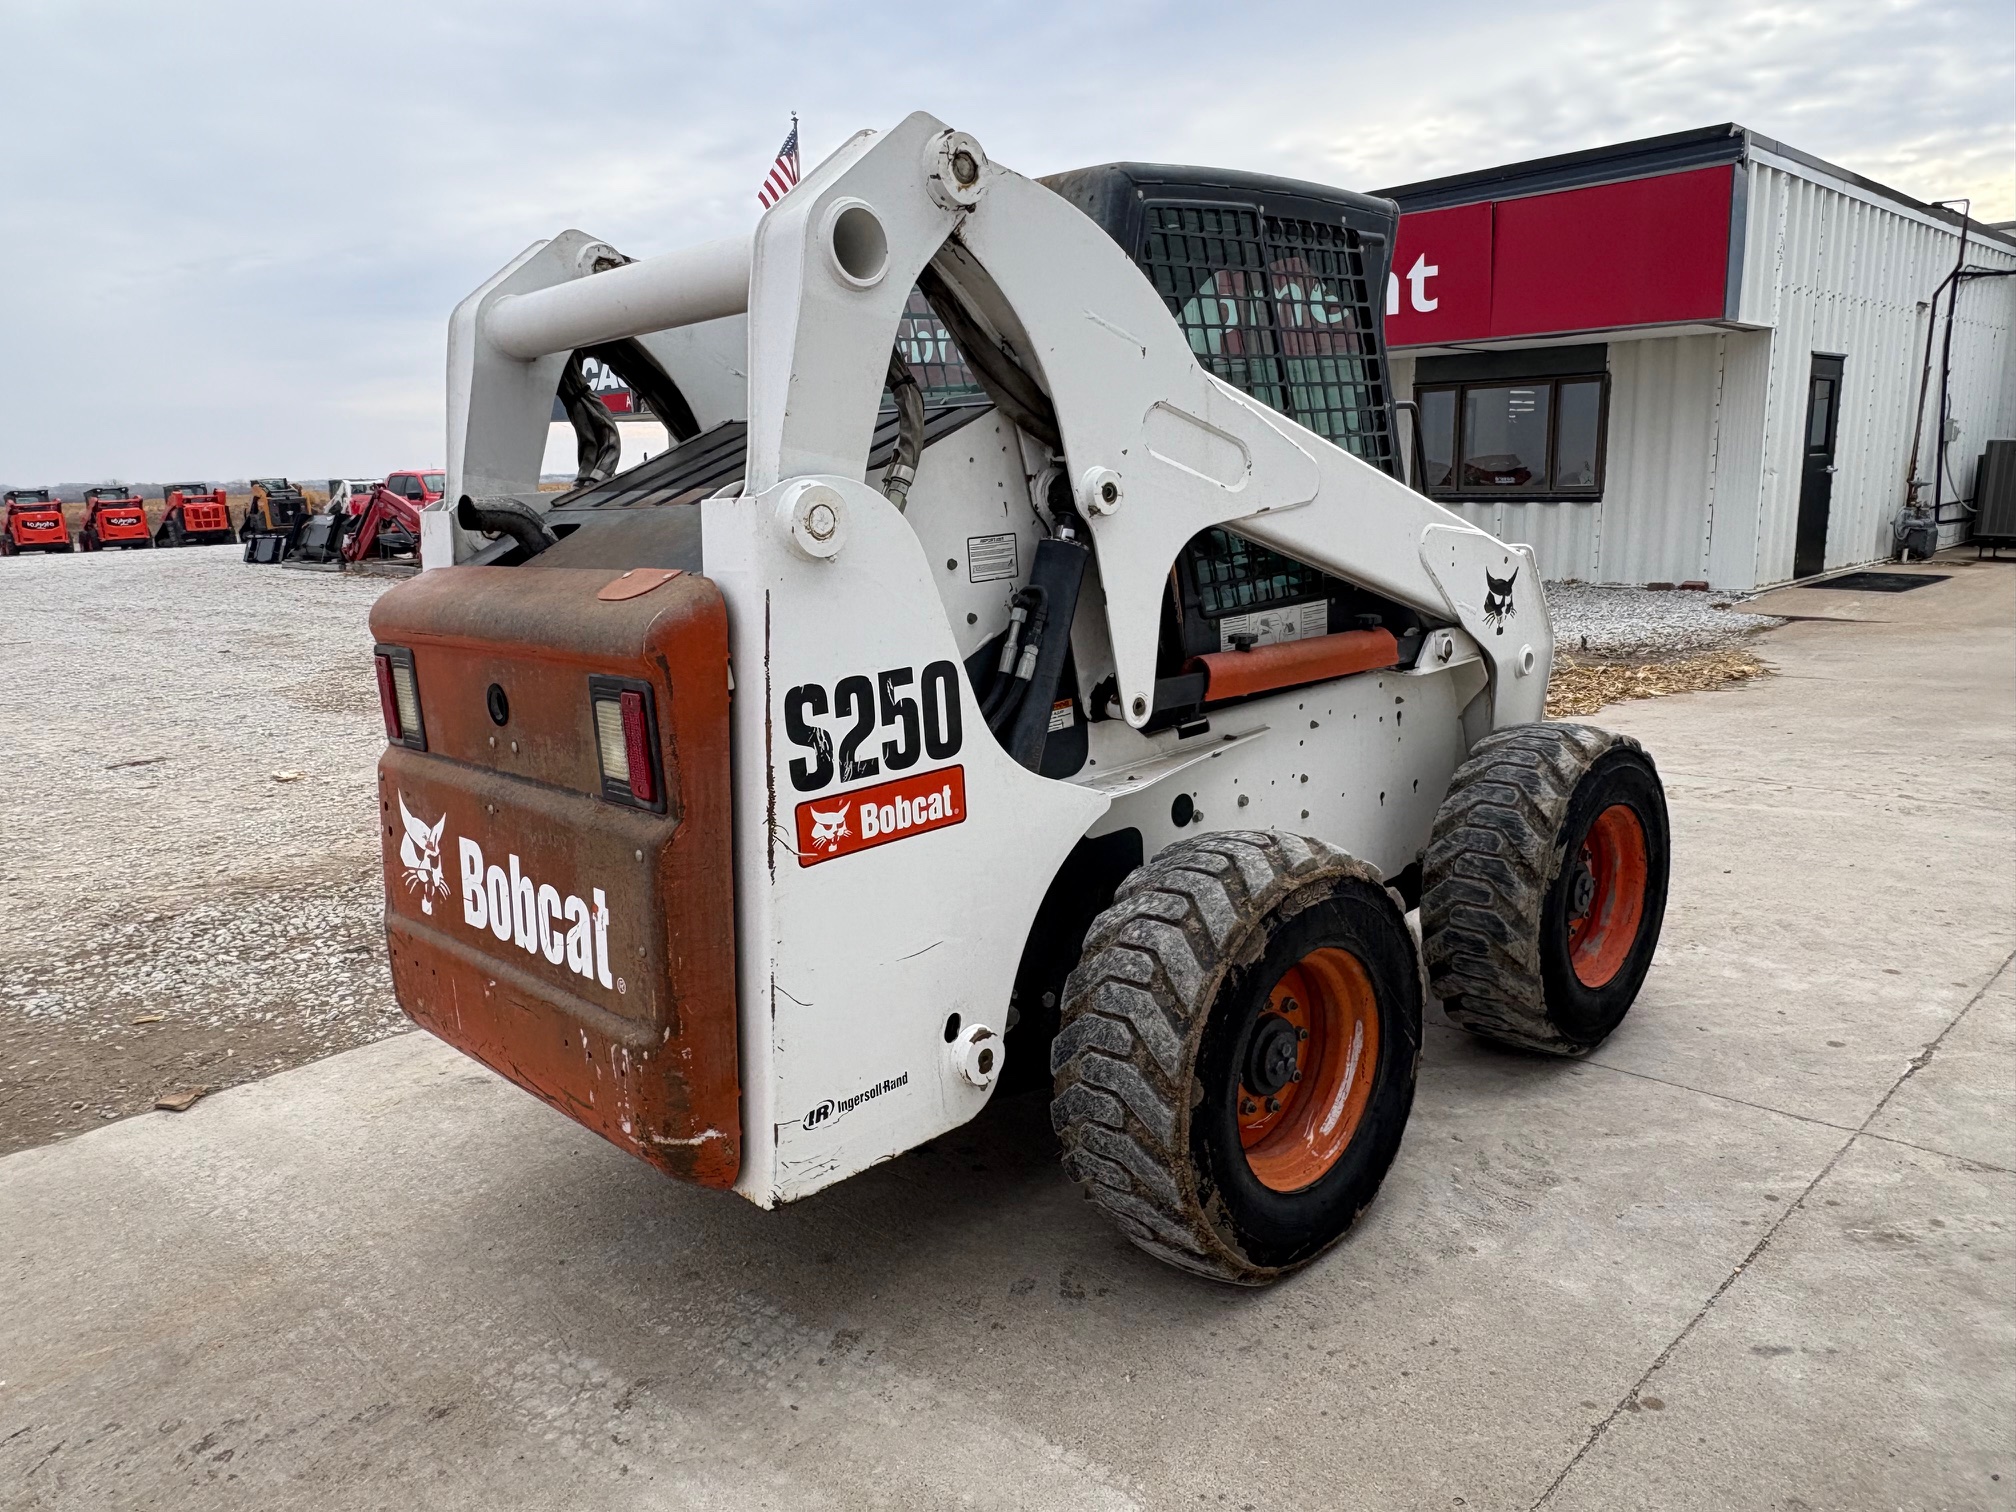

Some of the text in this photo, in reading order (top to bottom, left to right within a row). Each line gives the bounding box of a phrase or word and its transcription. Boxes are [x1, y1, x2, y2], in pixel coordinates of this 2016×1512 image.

[581, 356, 628, 391] CA
[784, 660, 963, 792] S250
[859, 784, 953, 840] Bobcat
[458, 836, 613, 990] Bobcat
